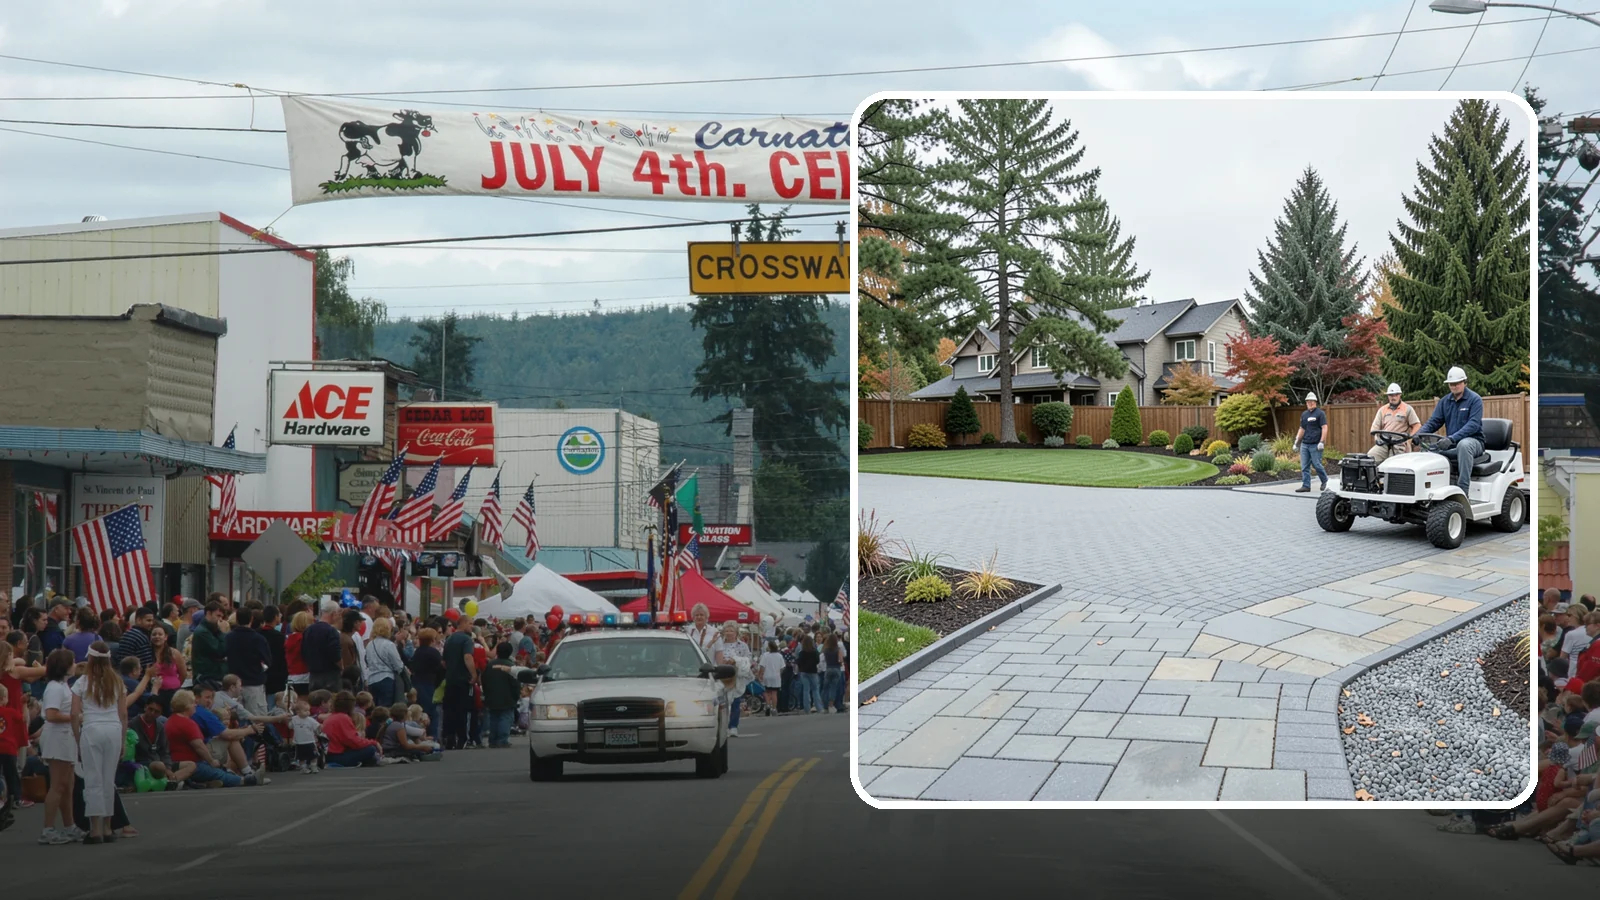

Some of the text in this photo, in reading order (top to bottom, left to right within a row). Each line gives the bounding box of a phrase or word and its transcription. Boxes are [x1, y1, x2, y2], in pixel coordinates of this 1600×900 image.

[481, 141, 605, 193] JULY
[633, 150, 747, 198] 4th.
[697, 254, 850, 280] CROSSWA
[283, 380, 374, 419] ACE
[406, 409, 453, 422] CEDAR
[283, 421, 371, 436] Hardware
[416, 428, 477, 446] Coca-Cola
[95, 485, 124, 495] Vincent
[126, 486, 136, 495] de
[138, 486, 155, 495] Paul
[81, 503, 153, 522] THT
[688, 526, 741, 535] CRNATION
[699, 535, 730, 543] GLASS
